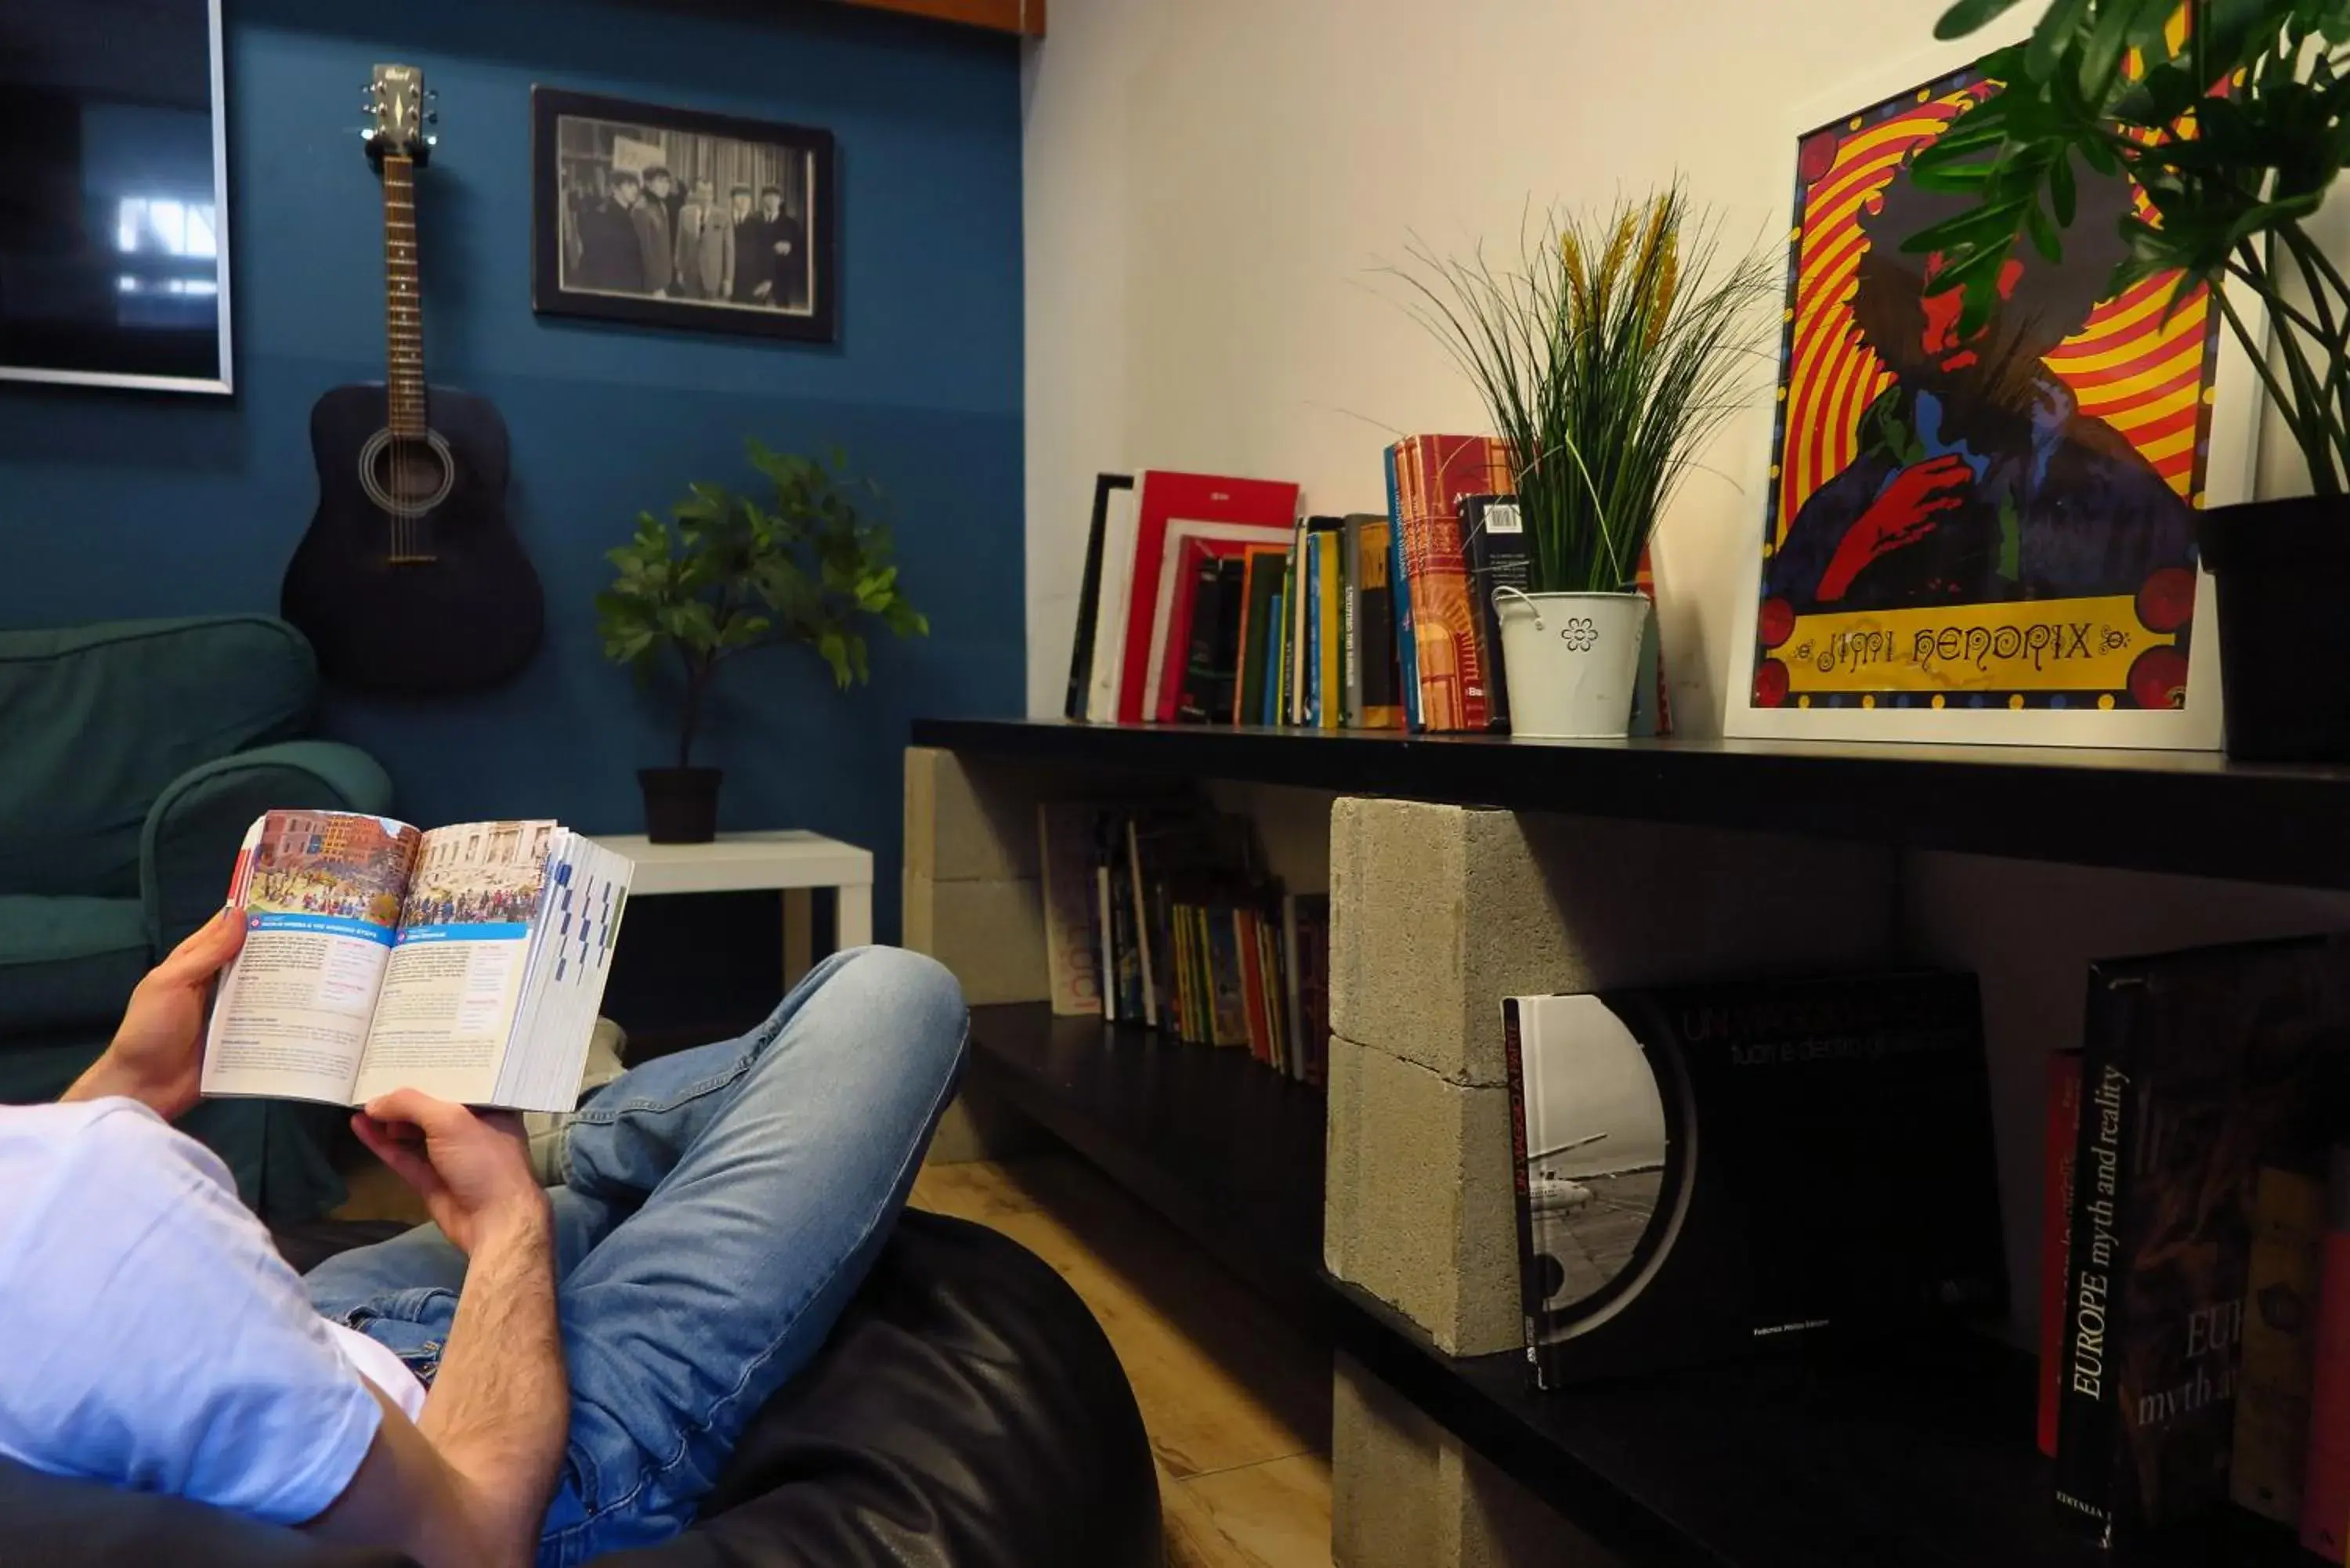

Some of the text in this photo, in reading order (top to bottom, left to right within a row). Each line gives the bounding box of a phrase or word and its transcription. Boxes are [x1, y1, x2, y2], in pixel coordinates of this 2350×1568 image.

[1817, 622, 2094, 674] JIMI HENDRIX
[2073, 1064, 2131, 1402] EUROPE myth and reality
